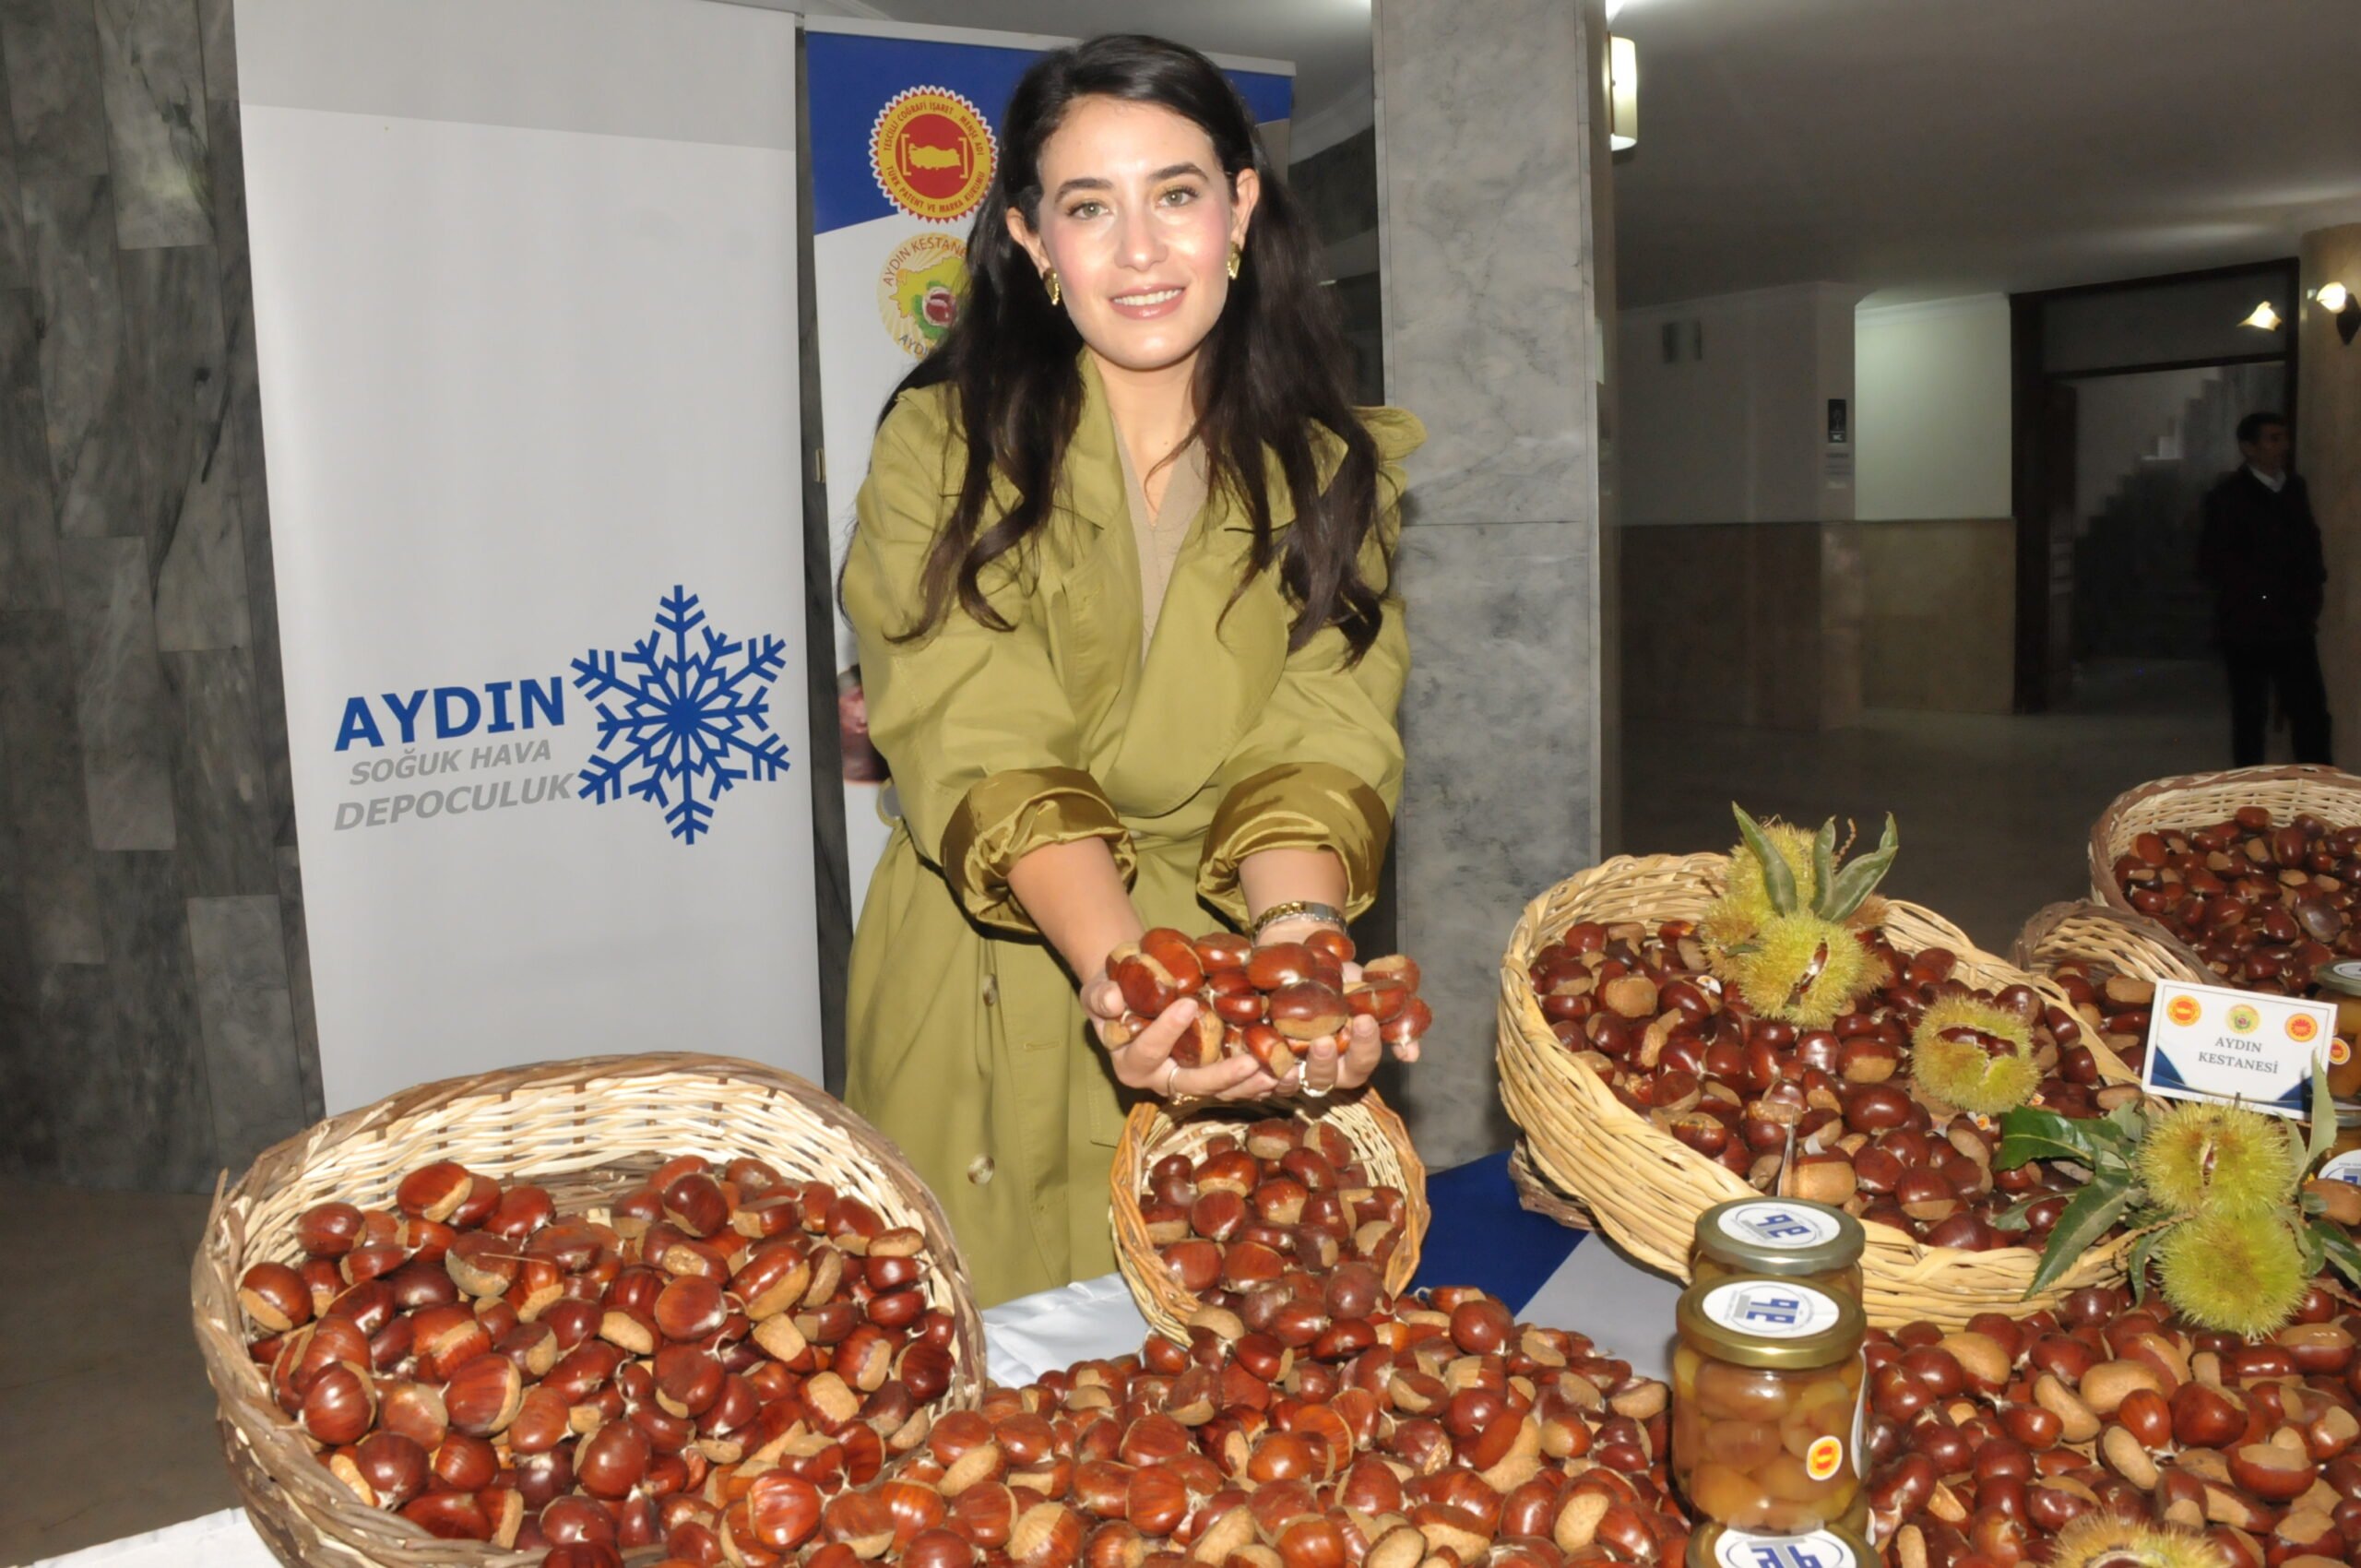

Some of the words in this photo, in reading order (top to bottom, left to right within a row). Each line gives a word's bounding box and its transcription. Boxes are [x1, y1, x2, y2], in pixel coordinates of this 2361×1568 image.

[884, 120, 899, 151] TESCİLLİ
[897, 101, 927, 122] COĞRAFİ
[930, 101, 954, 113] İŞARET
[959, 115, 979, 138] MENŞE
[975, 142, 984, 156] ADI
[886, 165, 900, 187] TÜRK
[899, 187, 924, 208] PATENT
[927, 204, 936, 212] VE
[939, 199, 964, 213] MARKA
[964, 171, 985, 202] KURUMU
[883, 247, 911, 287] AYDIN
[910, 236, 967, 258] KESTANE
[899, 334, 929, 355] AYDI
[334, 676, 565, 753] AYDIN
[349, 747, 463, 786] SOĞUK
[469, 739, 552, 771] HAVA
[333, 772, 575, 832] DEPOCULUK
[2198, 1051, 2279, 1075] KESTANESİ
[2214, 1037, 2262, 1053] AYDIN
